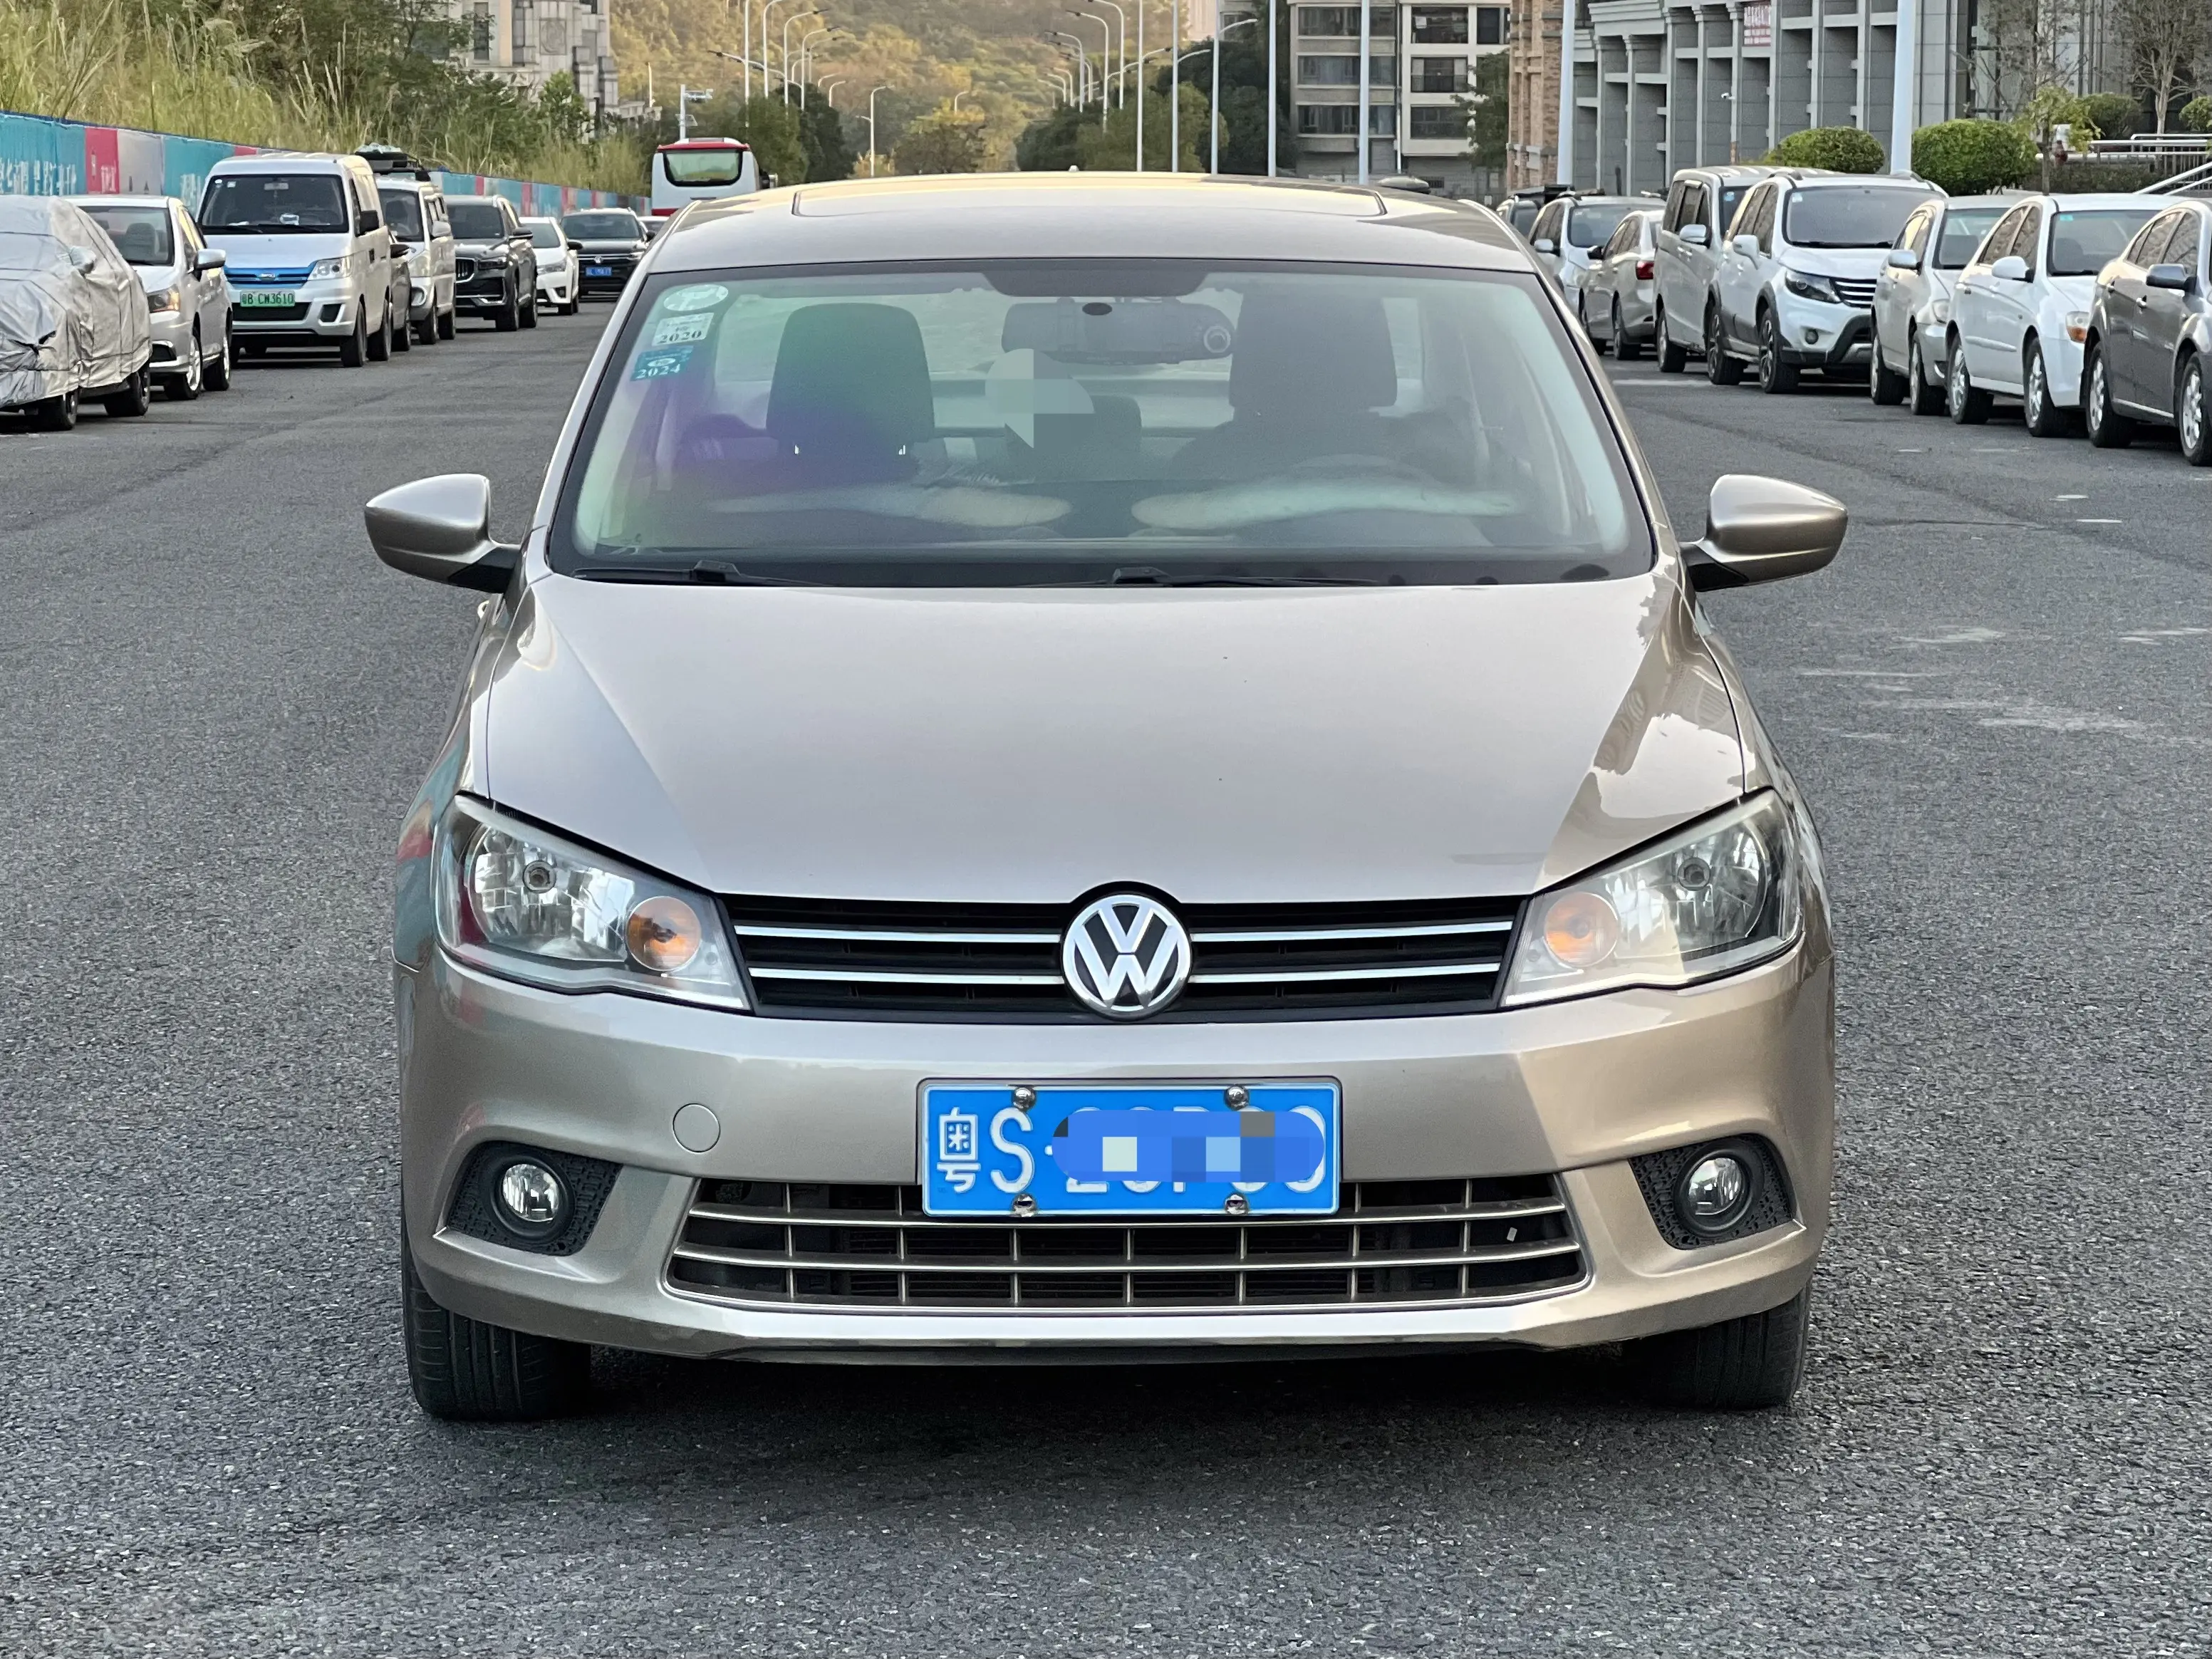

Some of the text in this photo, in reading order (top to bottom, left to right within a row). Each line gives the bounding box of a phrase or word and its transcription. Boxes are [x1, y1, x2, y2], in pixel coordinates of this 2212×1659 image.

[657, 330, 702, 344] 2020
[635, 363, 680, 379] 2024
[1071, 898, 1180, 1009] VW
